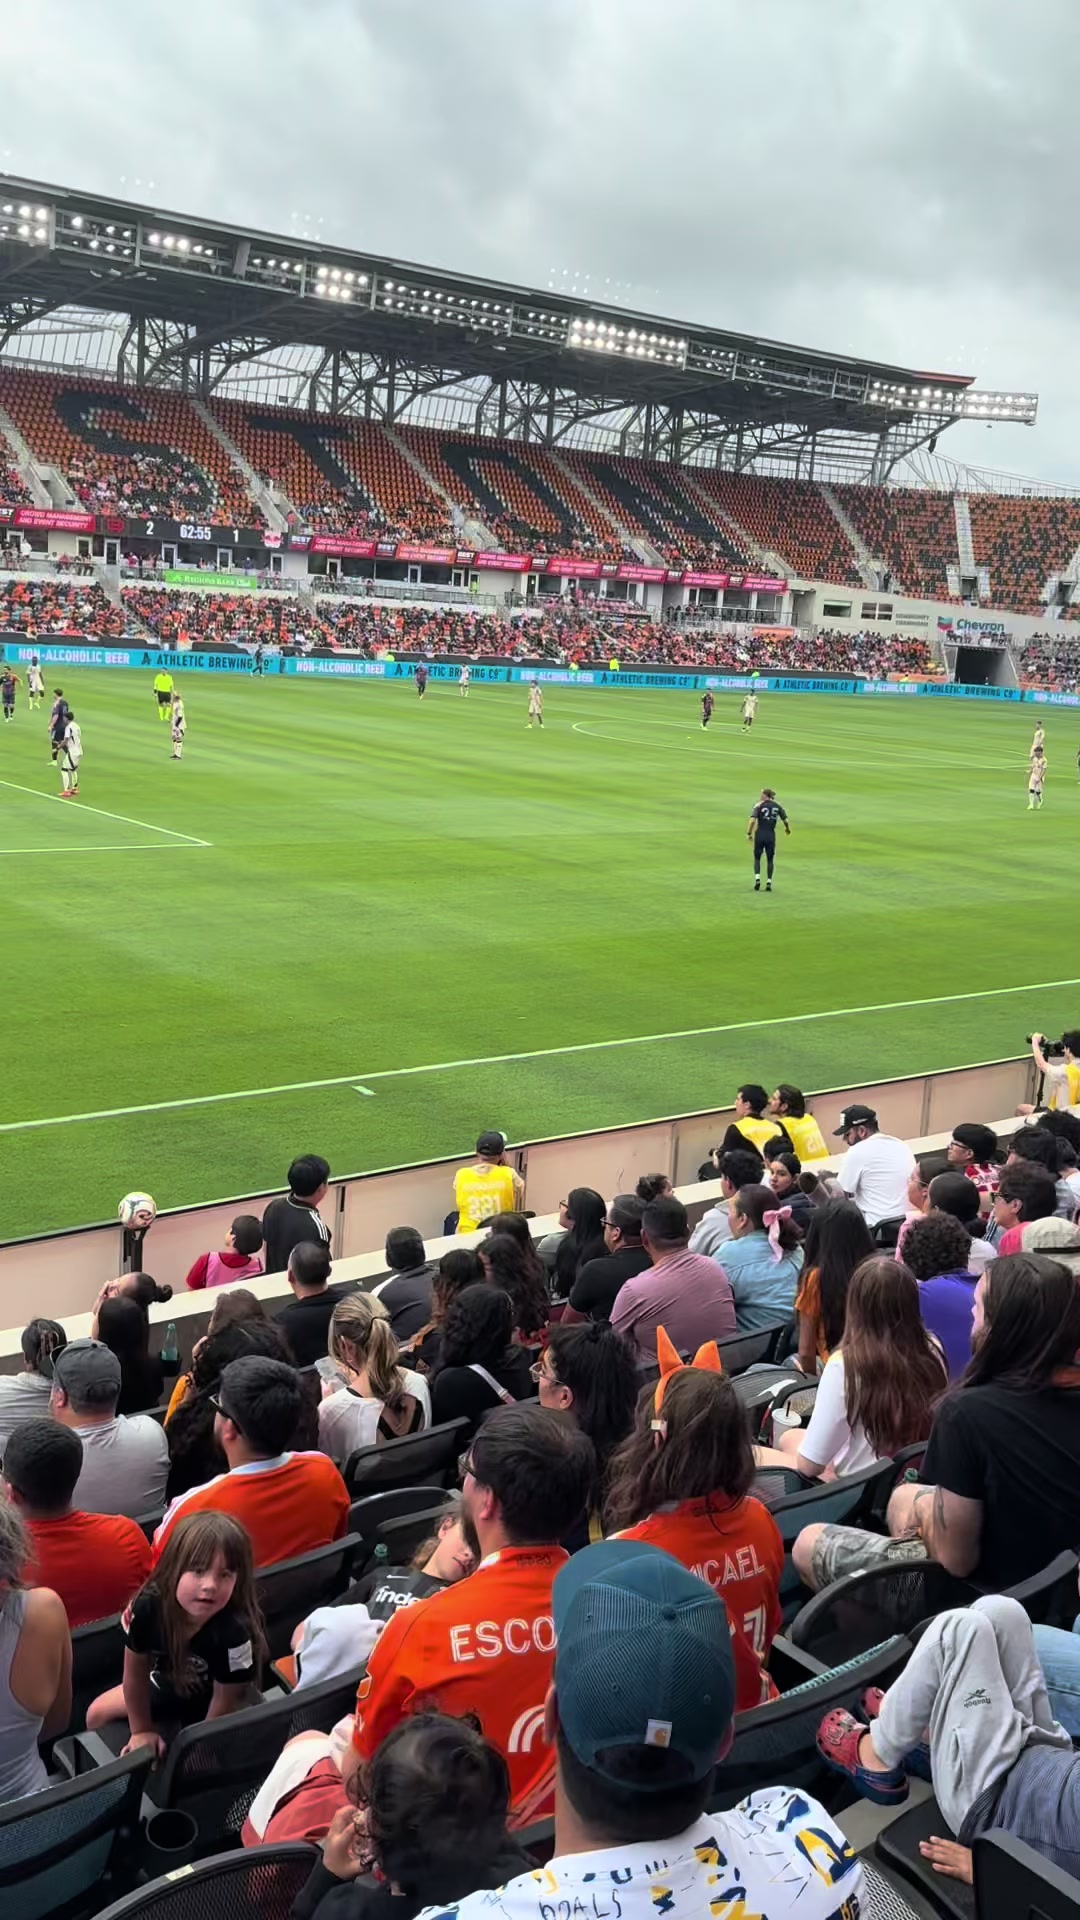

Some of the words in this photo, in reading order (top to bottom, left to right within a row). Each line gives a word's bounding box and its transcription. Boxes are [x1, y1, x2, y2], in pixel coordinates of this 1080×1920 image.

[146, 521, 154, 535] 2
[180, 524, 212, 541] 62:55
[233, 529, 239, 543] 1
[956, 618, 1005, 631] Chevron
[18, 647, 103, 663] NON-ALCOHOLIC
[105, 651, 130, 665] BEER
[156, 653, 207, 667] ATHLETIC
[208, 658, 253, 670] BREWING
[296, 661, 364, 673] NON-ALCOHOLIC
[365, 663, 385, 675] BEER
[407, 665, 446, 677] ATETIC
[449, 666, 485, 678] BRING
[761, 807, 779, 820] 25
[690, 1544, 767, 1587] ICAEL
[450, 1616, 557, 1662] ESCO
